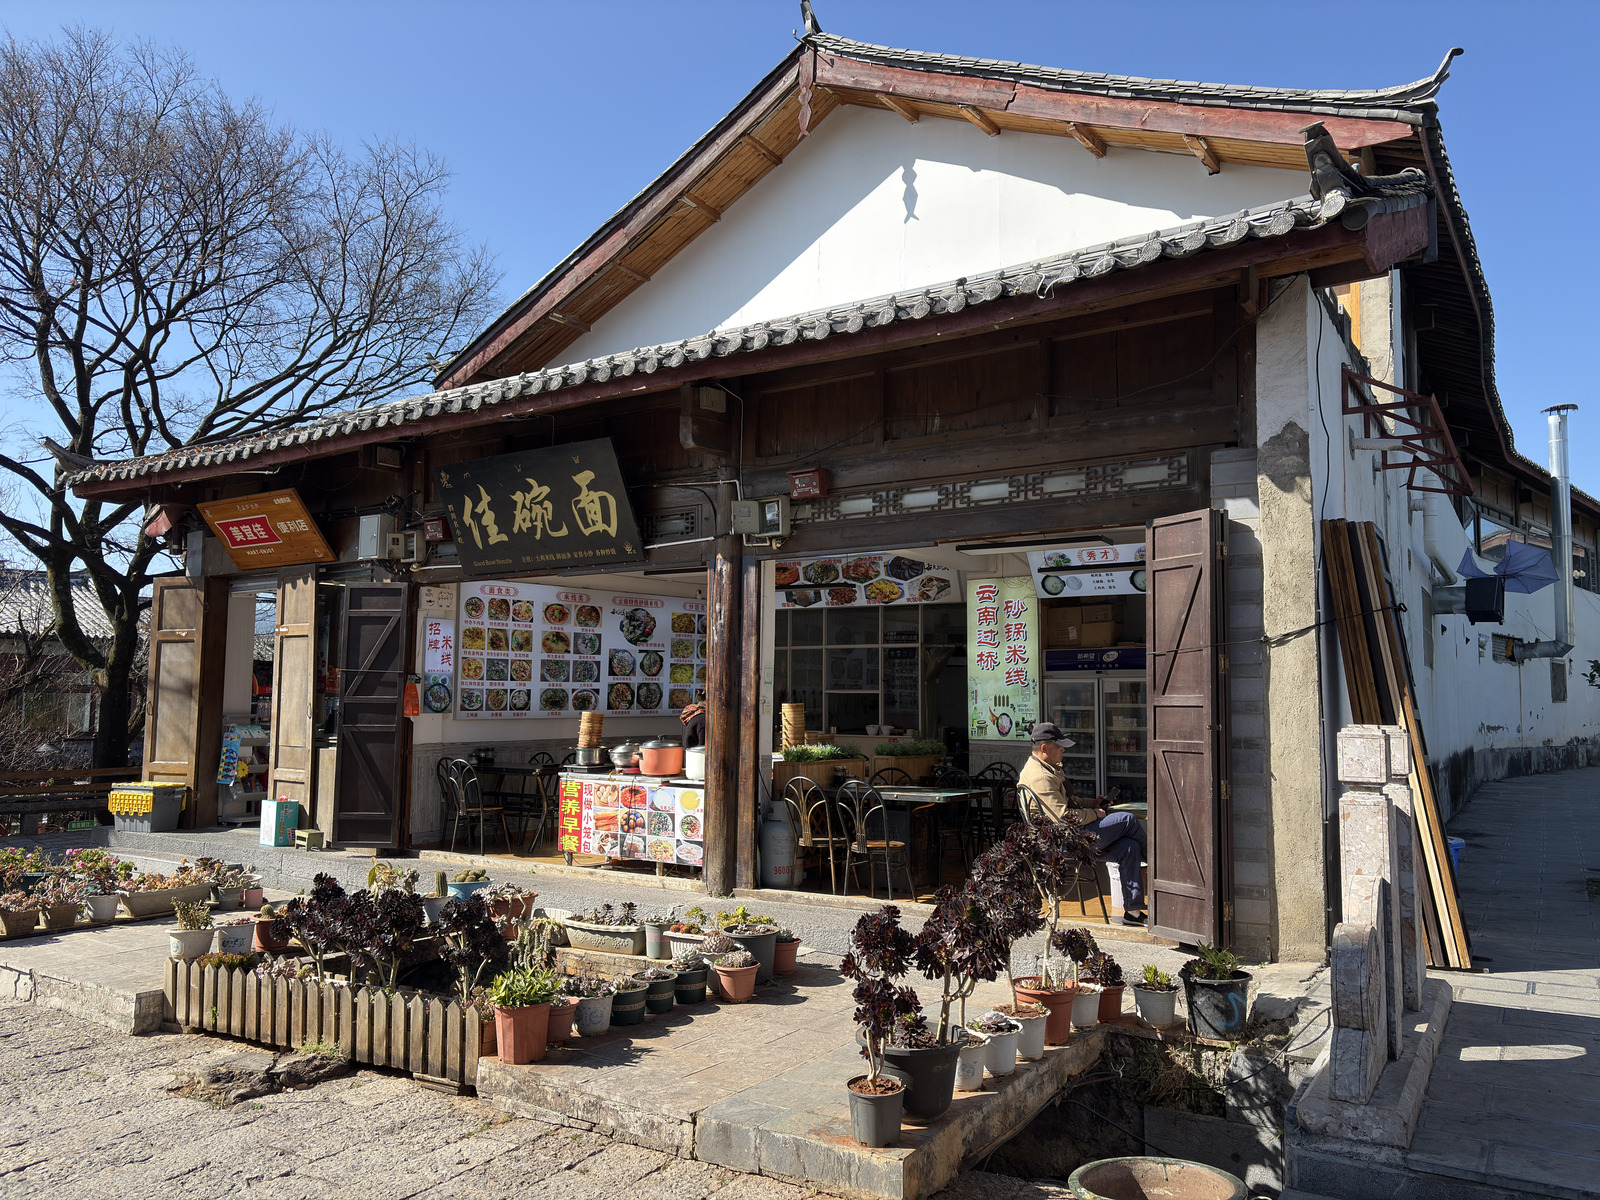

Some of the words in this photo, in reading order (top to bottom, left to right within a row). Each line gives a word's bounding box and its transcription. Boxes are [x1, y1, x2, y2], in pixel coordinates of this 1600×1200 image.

[462, 469, 618, 550] 佳碗面
[228, 522, 269, 542] 美宜佳
[276, 519, 309, 534] 便利店
[1086, 550, 1110, 561] 秀才
[489, 587, 511, 595] 面食类
[564, 594, 583, 602] 米线类
[428, 622, 441, 653] 招牌
[975, 584, 999, 670] 云南过桥
[441, 635, 453, 666] 米线
[1003, 599, 1029, 687] 砂锅米线
[560, 781, 581, 852] 营养早餐
[582, 783, 594, 854] 现做小笼包
